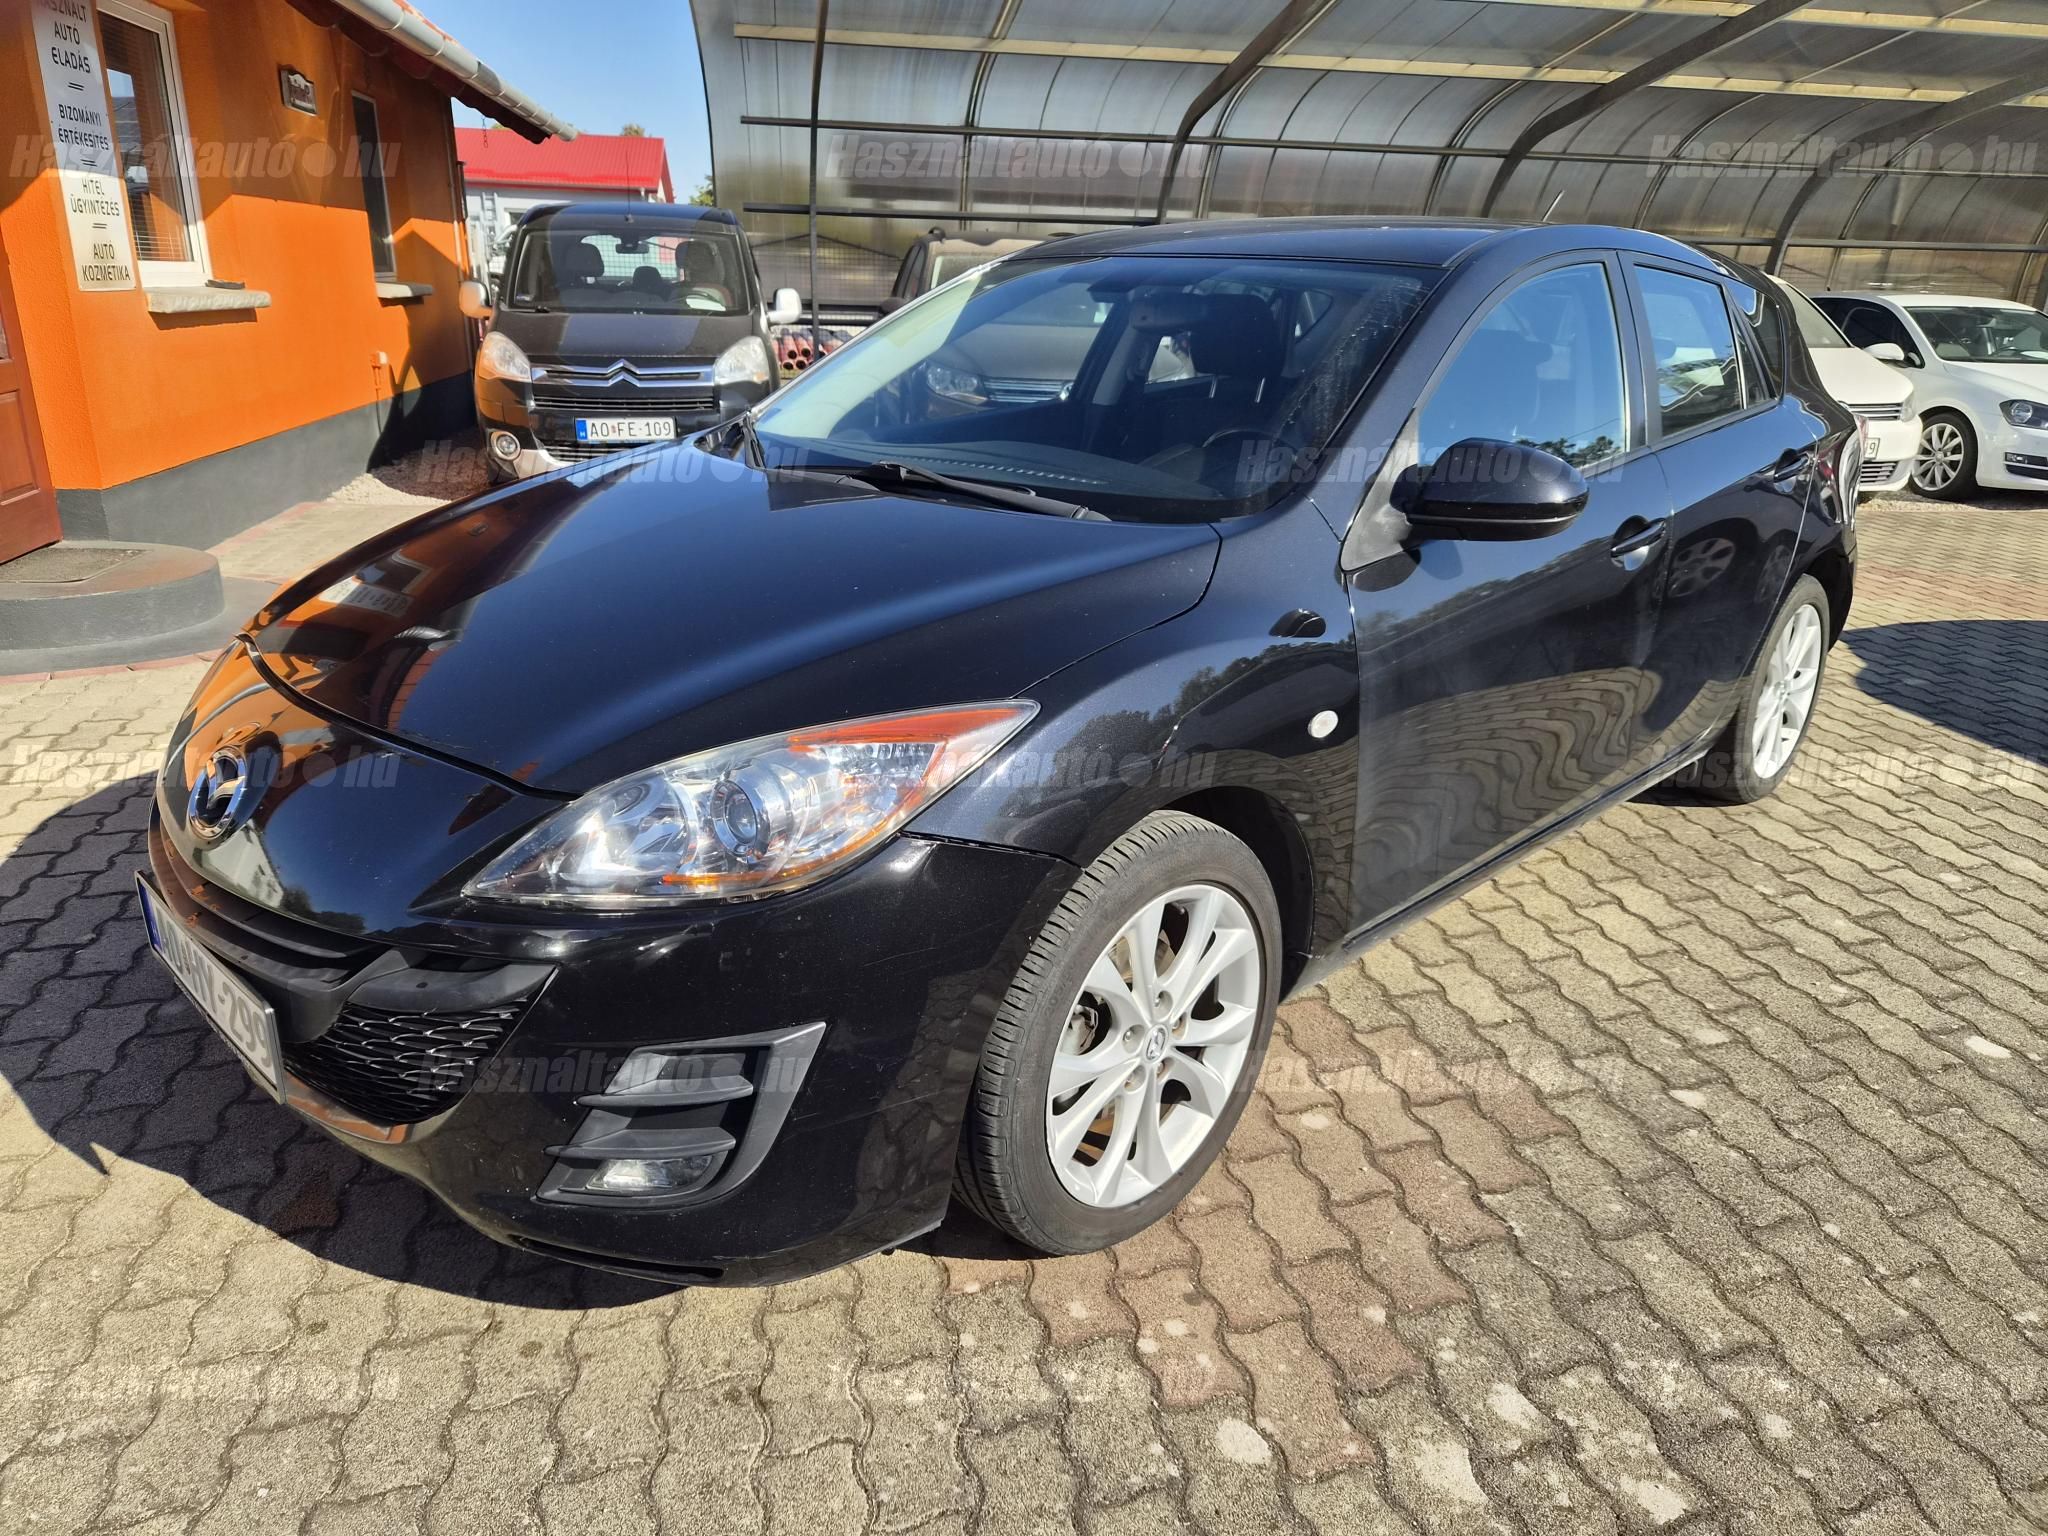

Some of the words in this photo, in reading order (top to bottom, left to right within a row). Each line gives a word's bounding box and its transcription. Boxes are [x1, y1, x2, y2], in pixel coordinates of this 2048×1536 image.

[54, 20, 80, 45] AUTÓ
[51, 46, 91, 74] ELADÁS
[58, 103, 102, 127] BIZOMÁNYI
[80, 178, 105, 196] HITEL
[69, 193, 121, 217] ÜGYINTÉZÉS
[92, 240, 115, 260] AUTÓ
[81, 265, 131, 281] KOZMETIKA
